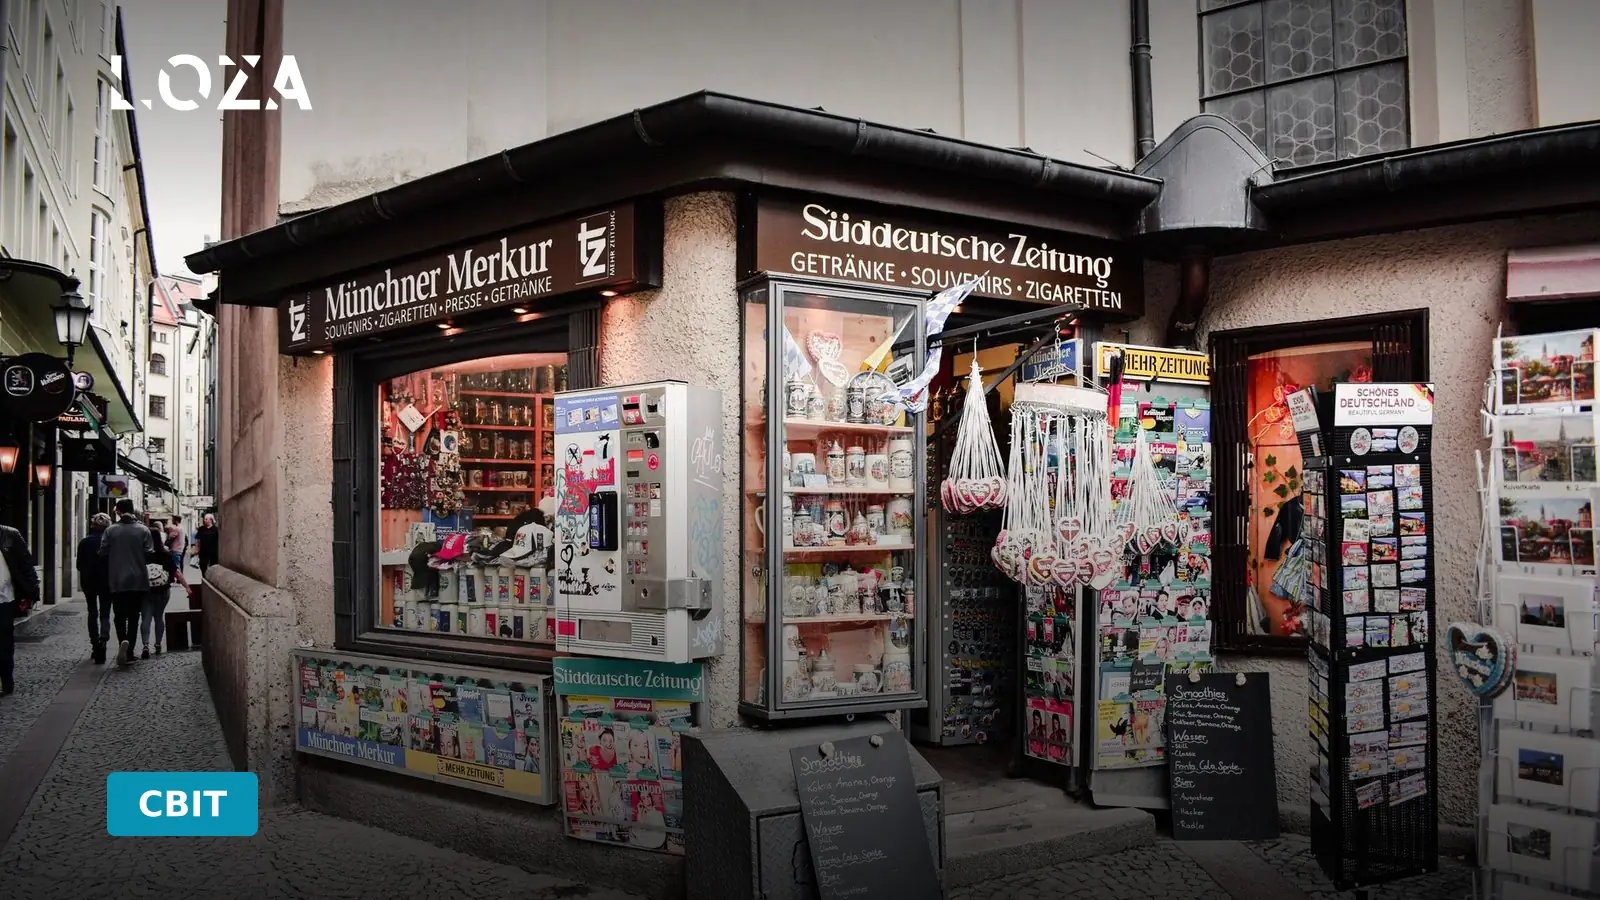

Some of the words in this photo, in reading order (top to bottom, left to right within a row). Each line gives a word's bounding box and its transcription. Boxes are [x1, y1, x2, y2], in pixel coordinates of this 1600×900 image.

[577, 222, 607, 277] tz
[801, 203, 1005, 264] Süddeutsche
[1008, 233, 1113, 288] Zeitung
[325, 267, 442, 323] Münchner
[446, 237, 553, 294] Merkur
[791, 252, 896, 282] GETRÄNKE
[1025, 281, 1122, 309] ZIGARETTEN
[325, 317, 373, 340] SOUVENIRS
[379, 302, 437, 328] ZIGARETTEN
[445, 291, 482, 314] PRESSE
[491, 275, 552, 304] GETRÄNKE
[289, 299, 306, 341] tz
[1159, 357, 1210, 376] ZEITUNG
[1340, 398, 1415, 408] DEUTSCHLAND
[1357, 387, 1399, 397] SCHÖNES
[554, 666, 642, 687] Süddeutsche
[643, 669, 702, 696] Zeitung
[1173, 684, 1226, 699] Smoothies
[1173, 729, 1206, 741] Wasser
[307, 731, 355, 756] Münchner
[357, 741, 396, 765] Merkur
[445, 762, 466, 776] MEHR
[466, 767, 495, 782] ZEITUNG
[800, 750, 862, 772] Smoothies
[1174, 776, 1194, 787] Bier
[811, 820, 843, 834] Wasser
